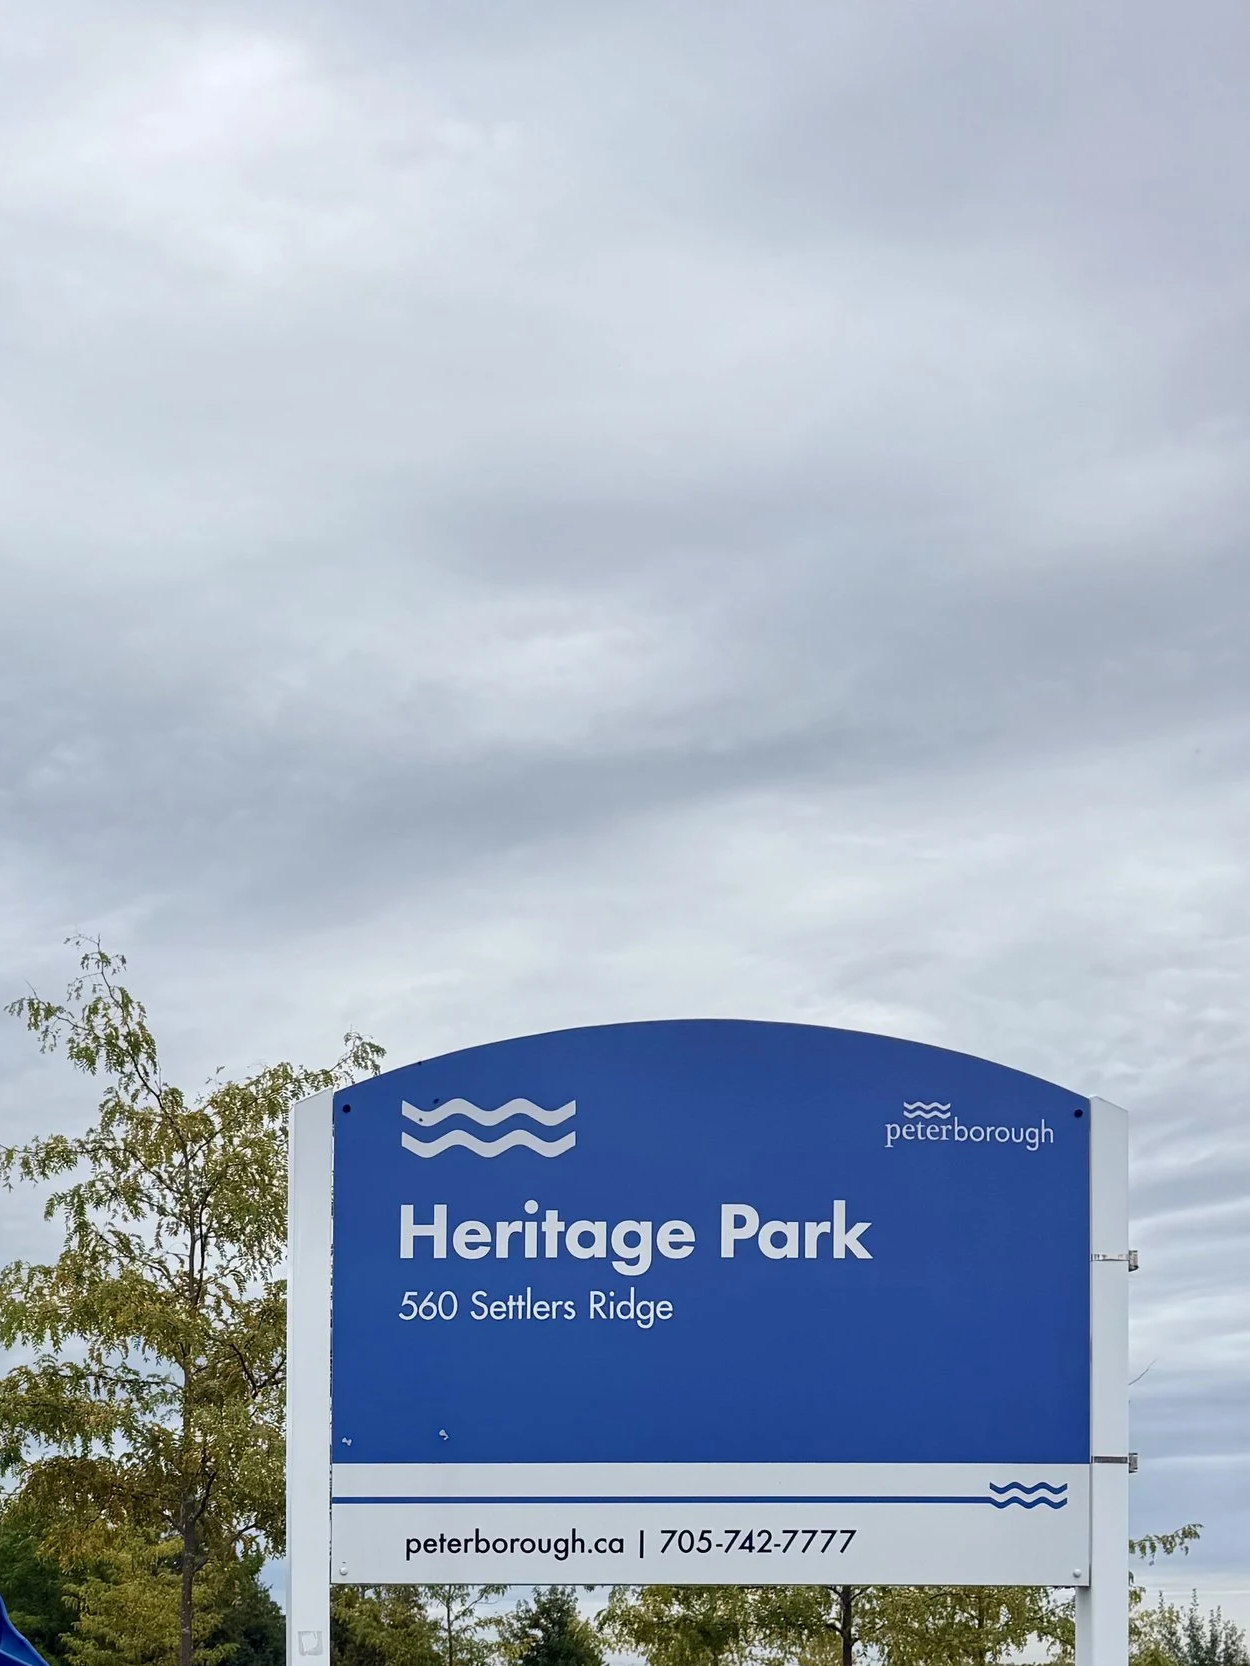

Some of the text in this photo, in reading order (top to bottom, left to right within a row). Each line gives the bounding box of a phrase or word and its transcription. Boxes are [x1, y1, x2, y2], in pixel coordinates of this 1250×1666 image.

[884, 1117, 1054, 1151] peterborough
[399, 1199, 874, 1276] Heritage Park
[398, 1286, 674, 1329] 560 Settlers Ridge
[405, 1527, 624, 1562] peterborough.ca
[660, 1529, 857, 1554] 705-742-7777
